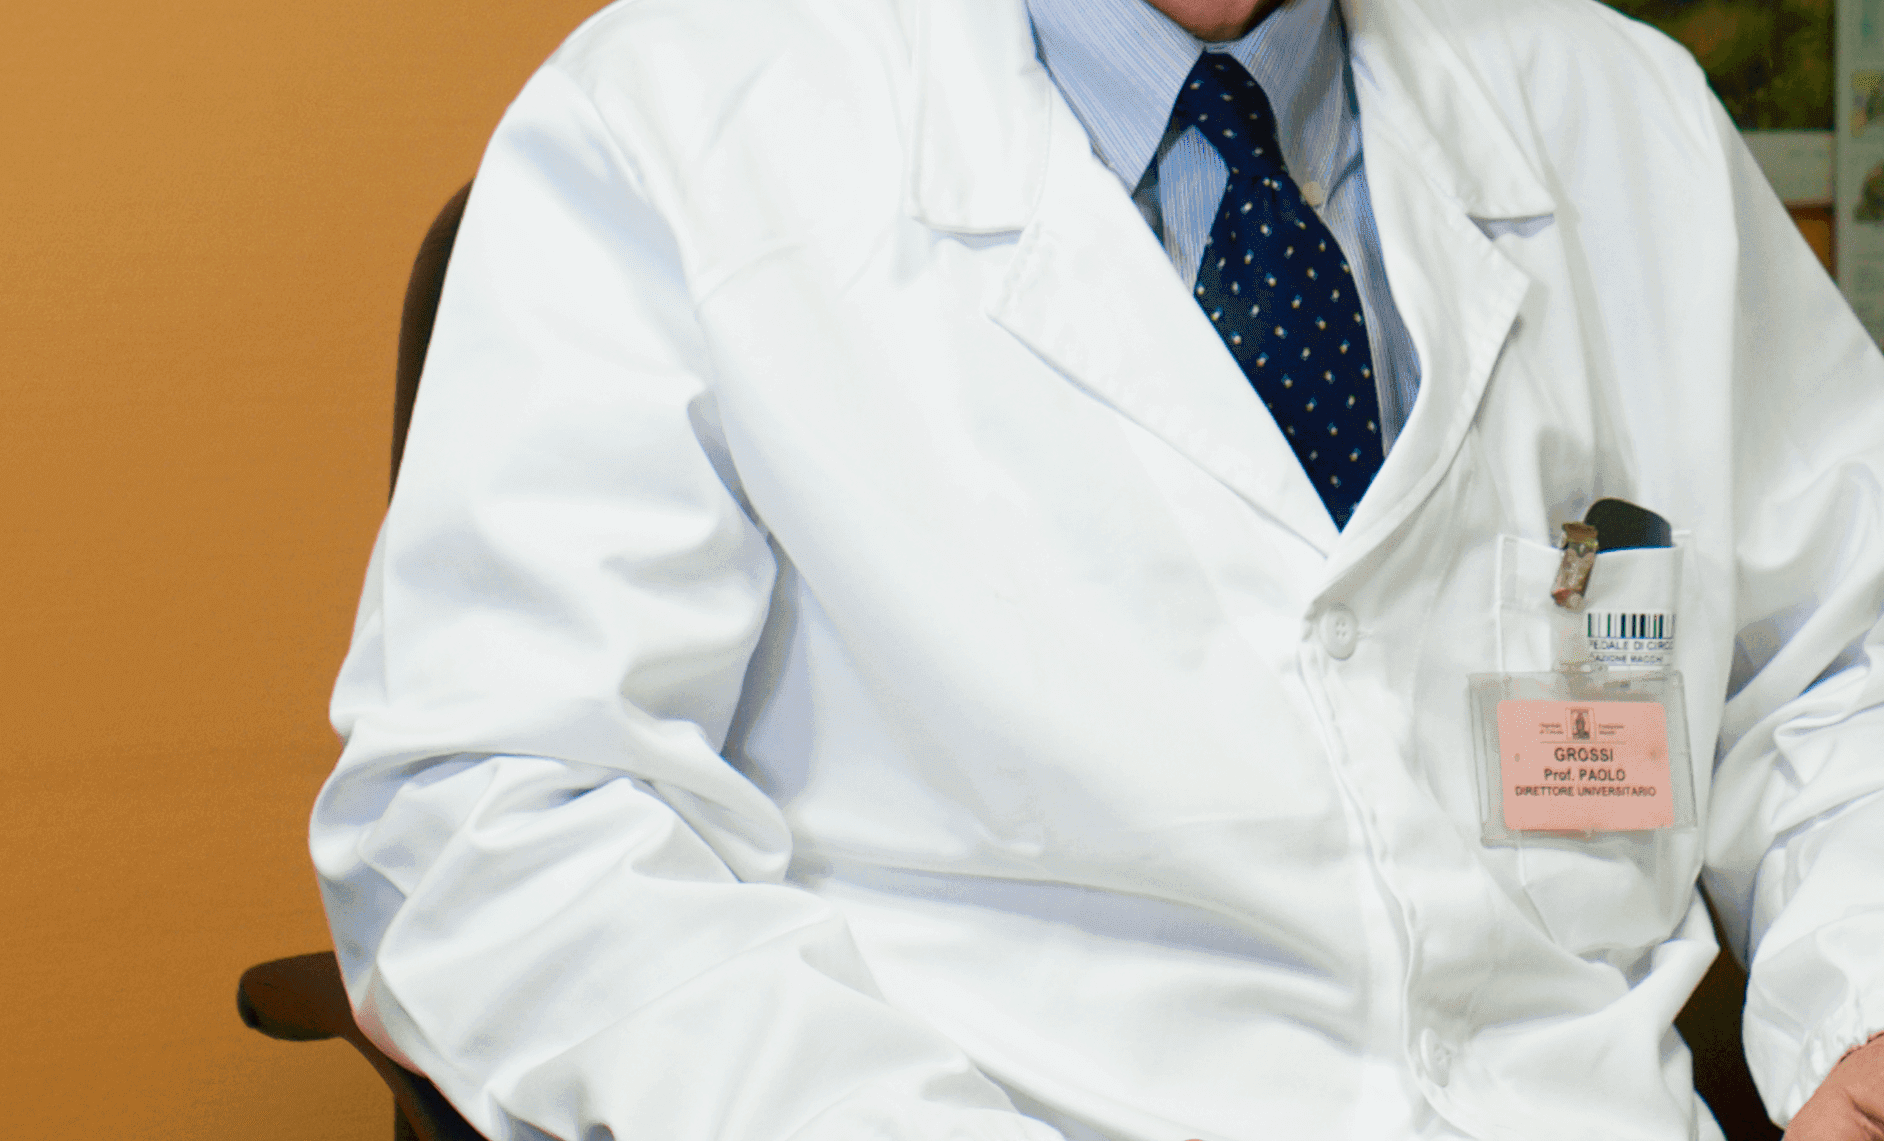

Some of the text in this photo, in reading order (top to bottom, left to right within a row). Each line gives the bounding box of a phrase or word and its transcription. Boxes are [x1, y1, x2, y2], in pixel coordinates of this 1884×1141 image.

[1554, 747, 1614, 762] GROSSI
[1543, 768, 1626, 782] Prof. PAOLO
[1515, 786, 1657, 798] DIRETTORE UNIVERSITARIO
